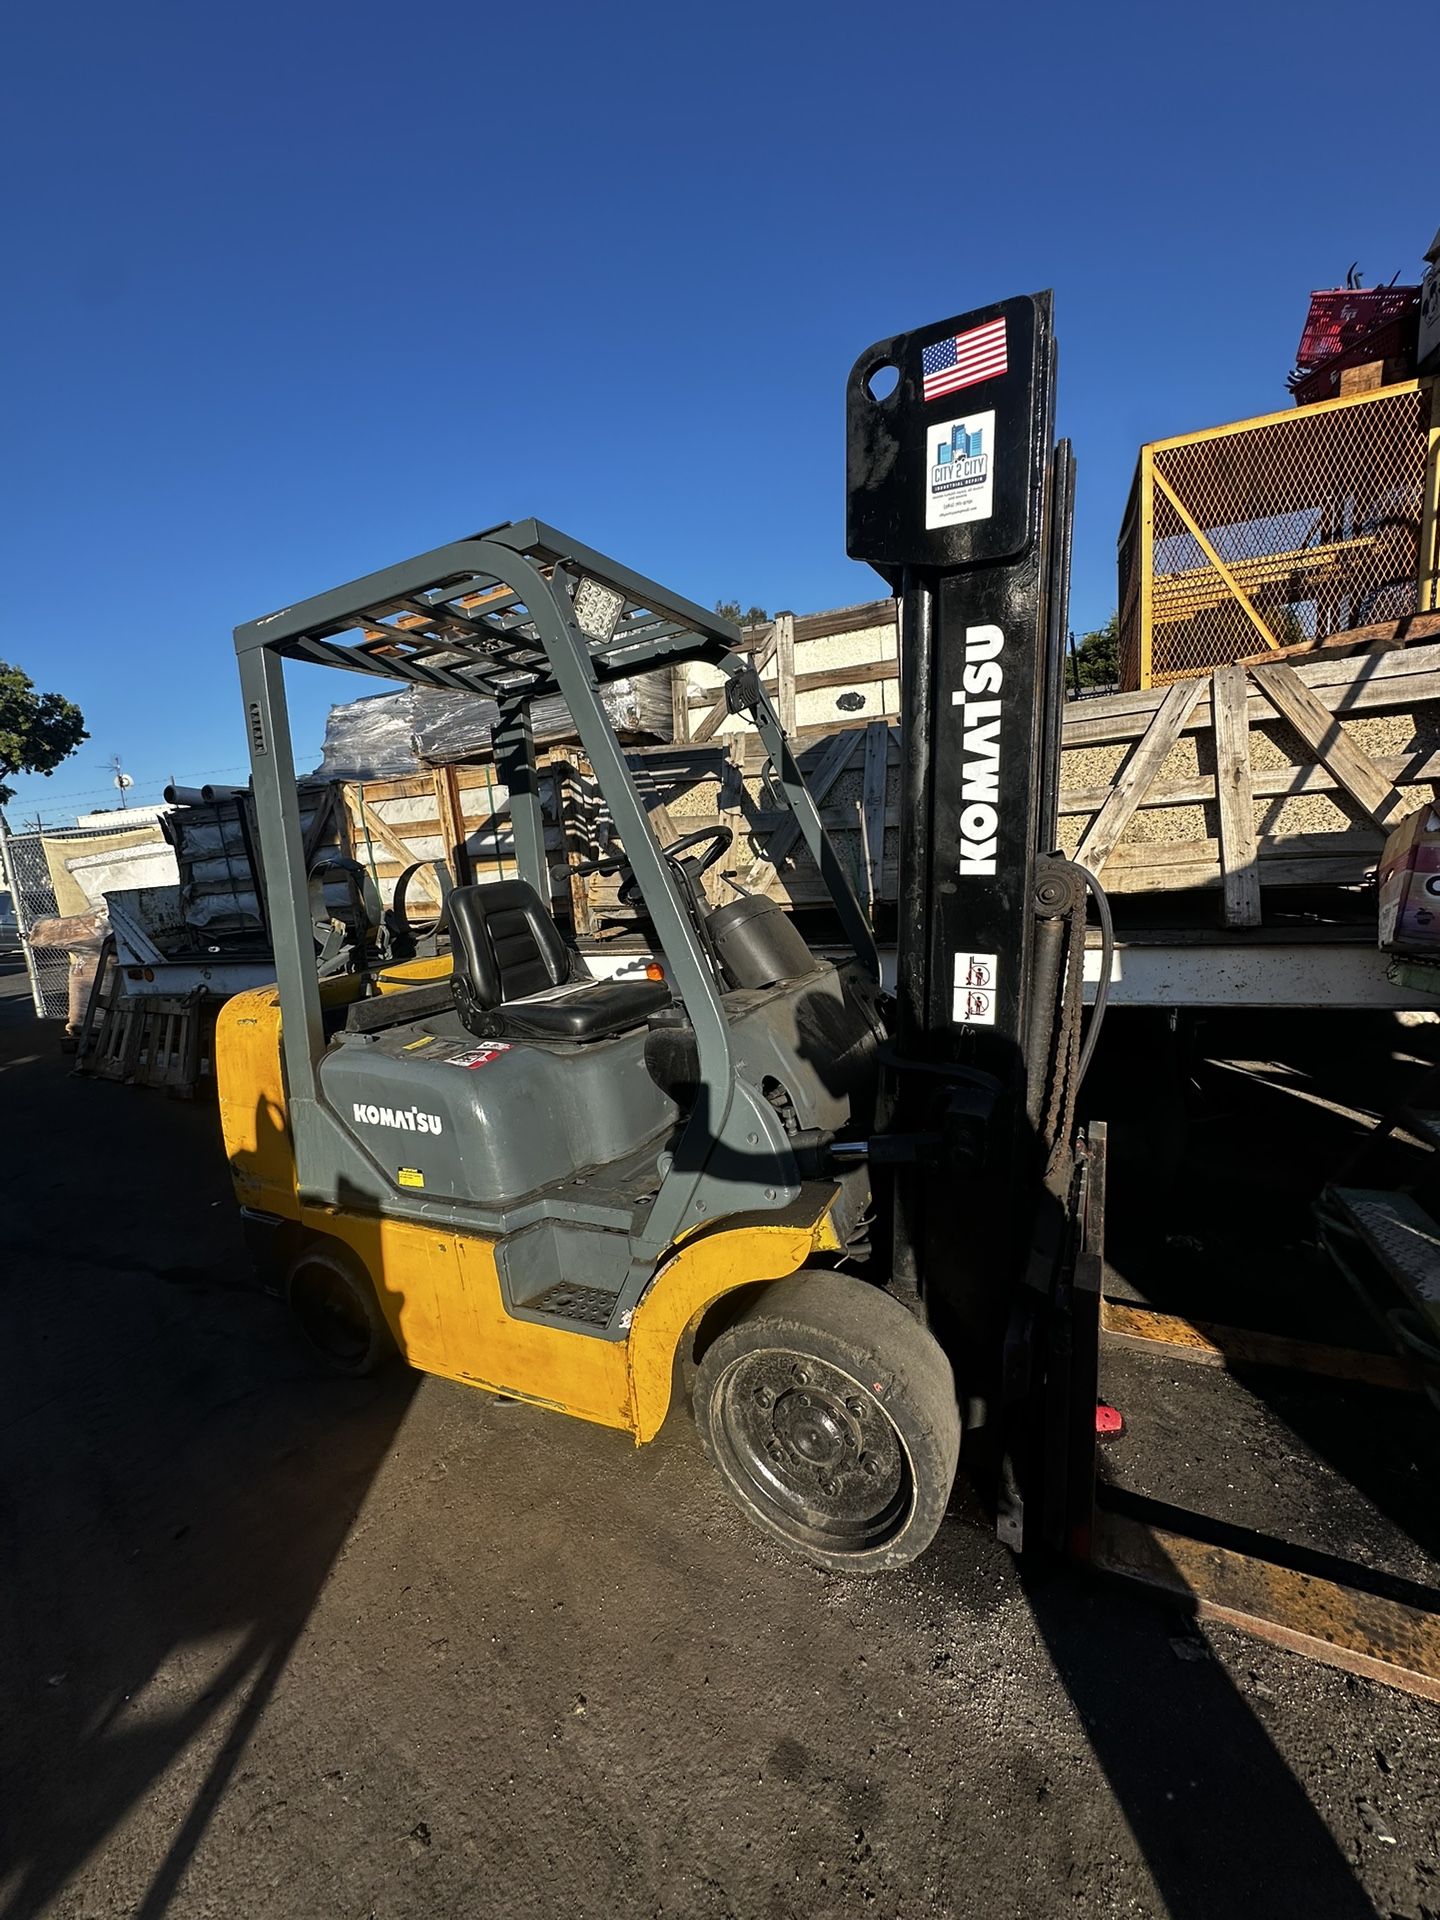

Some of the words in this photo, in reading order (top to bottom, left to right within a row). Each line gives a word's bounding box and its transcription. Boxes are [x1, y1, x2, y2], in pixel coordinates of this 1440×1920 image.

[935, 465, 953, 482] CITY
[956, 463, 962, 478] 2
[964, 457, 984, 476] CITY
[952, 624, 1005, 876] KOMATSU
[353, 1103, 442, 1136] KOMATSU
